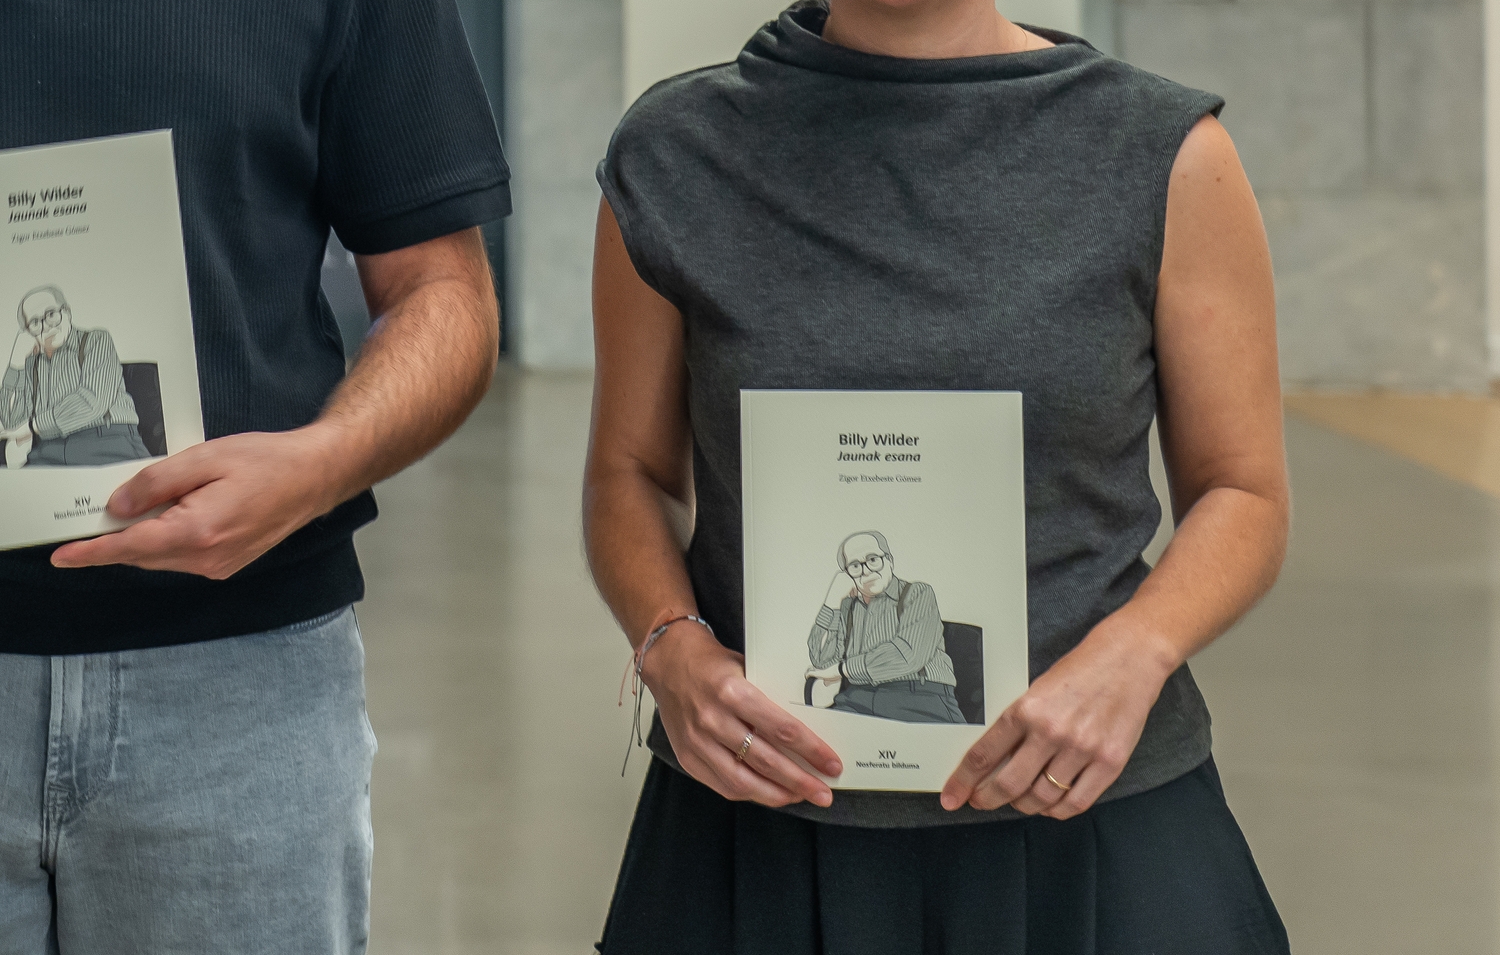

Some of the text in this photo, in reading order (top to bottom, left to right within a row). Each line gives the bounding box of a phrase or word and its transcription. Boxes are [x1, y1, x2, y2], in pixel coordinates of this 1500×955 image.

[8, 184, 84, 208] Billy Wilder
[8, 202, 87, 224] Jaunak esana
[839, 433, 920, 449] Billy Wilder
[837, 450, 921, 462] Jaunak esana
[839, 474, 858, 484] Zigor
[860, 473, 894, 482] Etxebeste
[74, 495, 91, 508] XIV
[878, 750, 896, 759] XIV
[856, 760, 890, 768] Nosferatu
